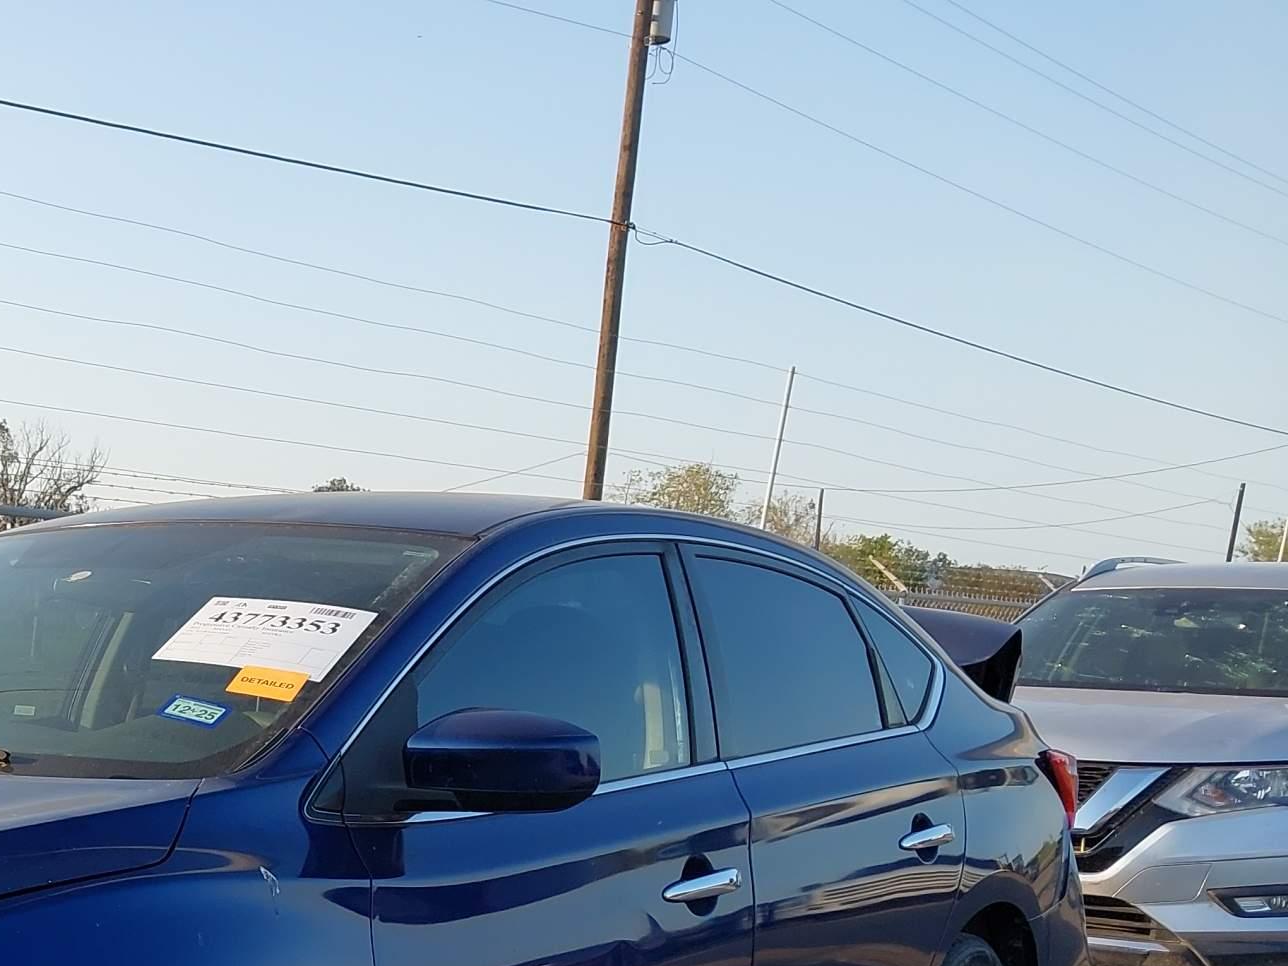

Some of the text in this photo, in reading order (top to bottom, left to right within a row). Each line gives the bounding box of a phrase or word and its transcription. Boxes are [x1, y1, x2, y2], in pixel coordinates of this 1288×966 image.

[208, 611, 341, 635] 43773353
[240, 676, 295, 690] DETAILED
[172, 703, 219, 721] 12 25
